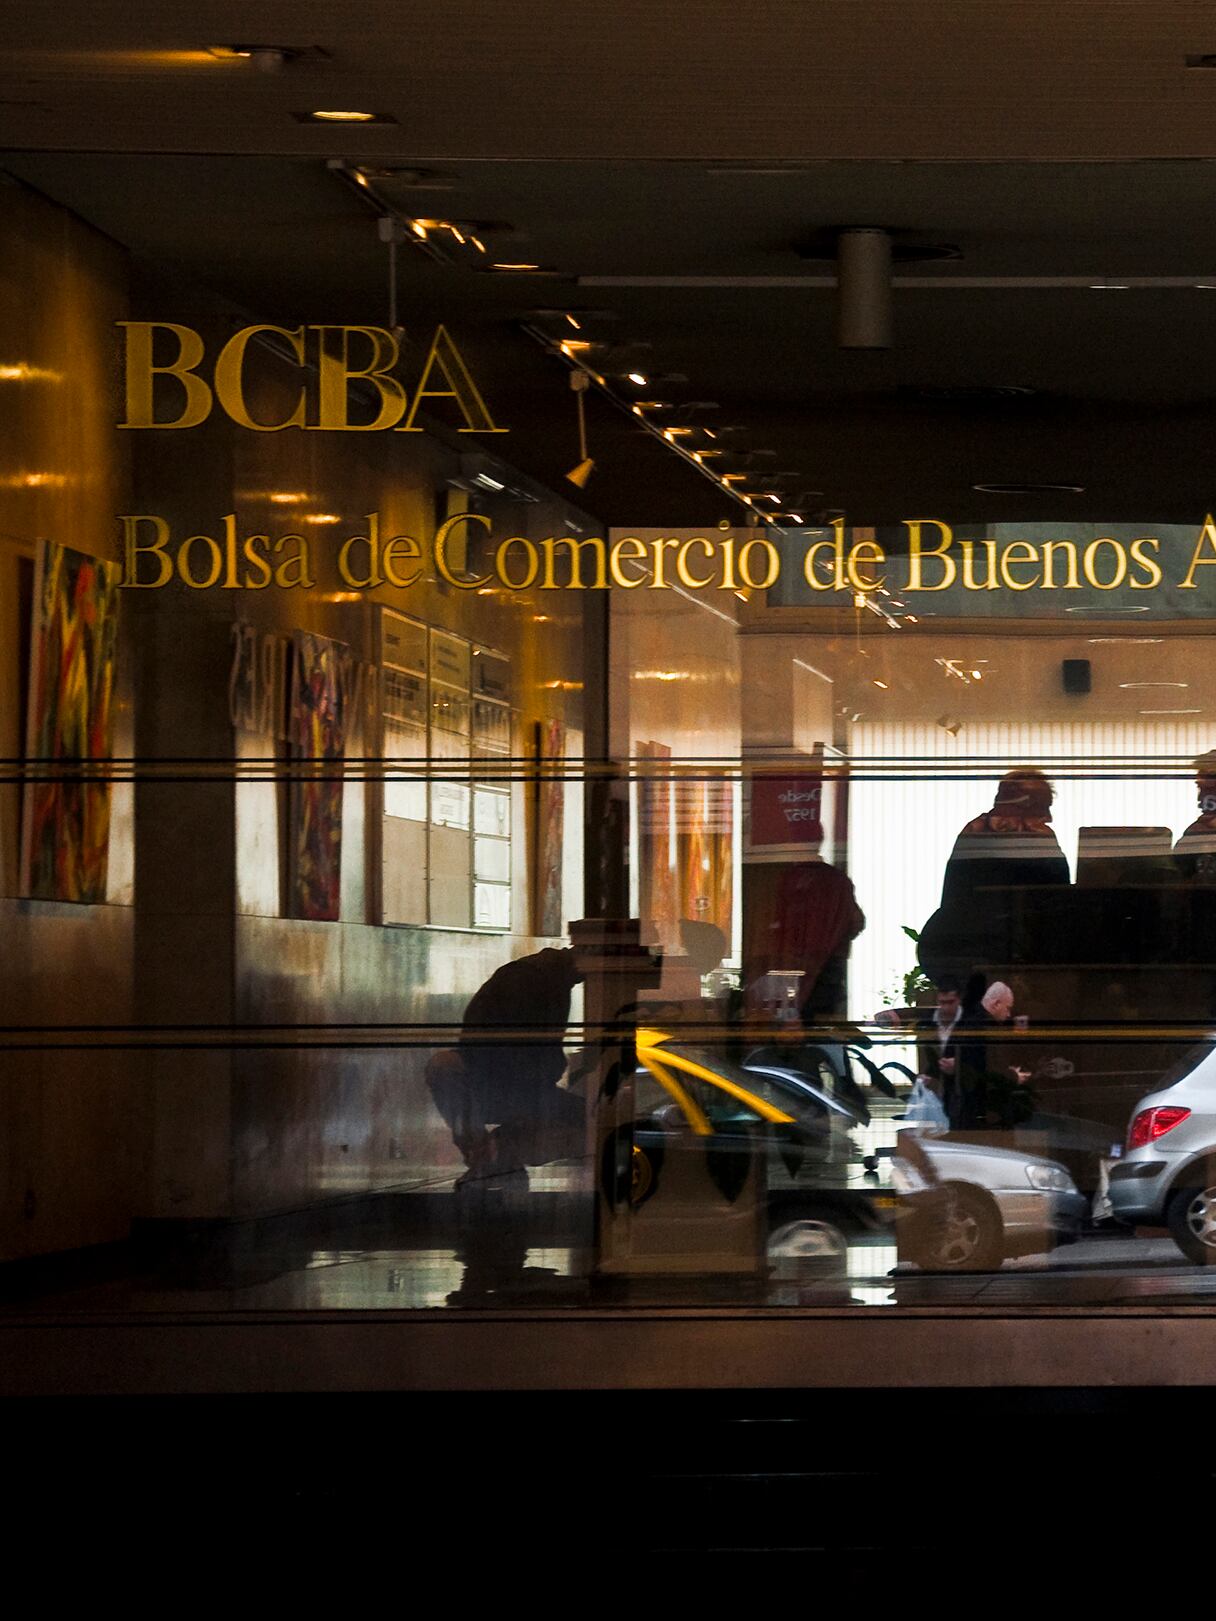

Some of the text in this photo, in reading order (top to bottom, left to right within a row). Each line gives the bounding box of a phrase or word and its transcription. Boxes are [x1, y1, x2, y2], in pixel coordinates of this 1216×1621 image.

[115, 321, 510, 433] BCBA
[115, 512, 316, 590] Bolsa
[337, 512, 424, 589] de
[433, 511, 781, 591] Comercio
[803, 514, 887, 592] de
[900, 517, 1162, 591] Buenos
